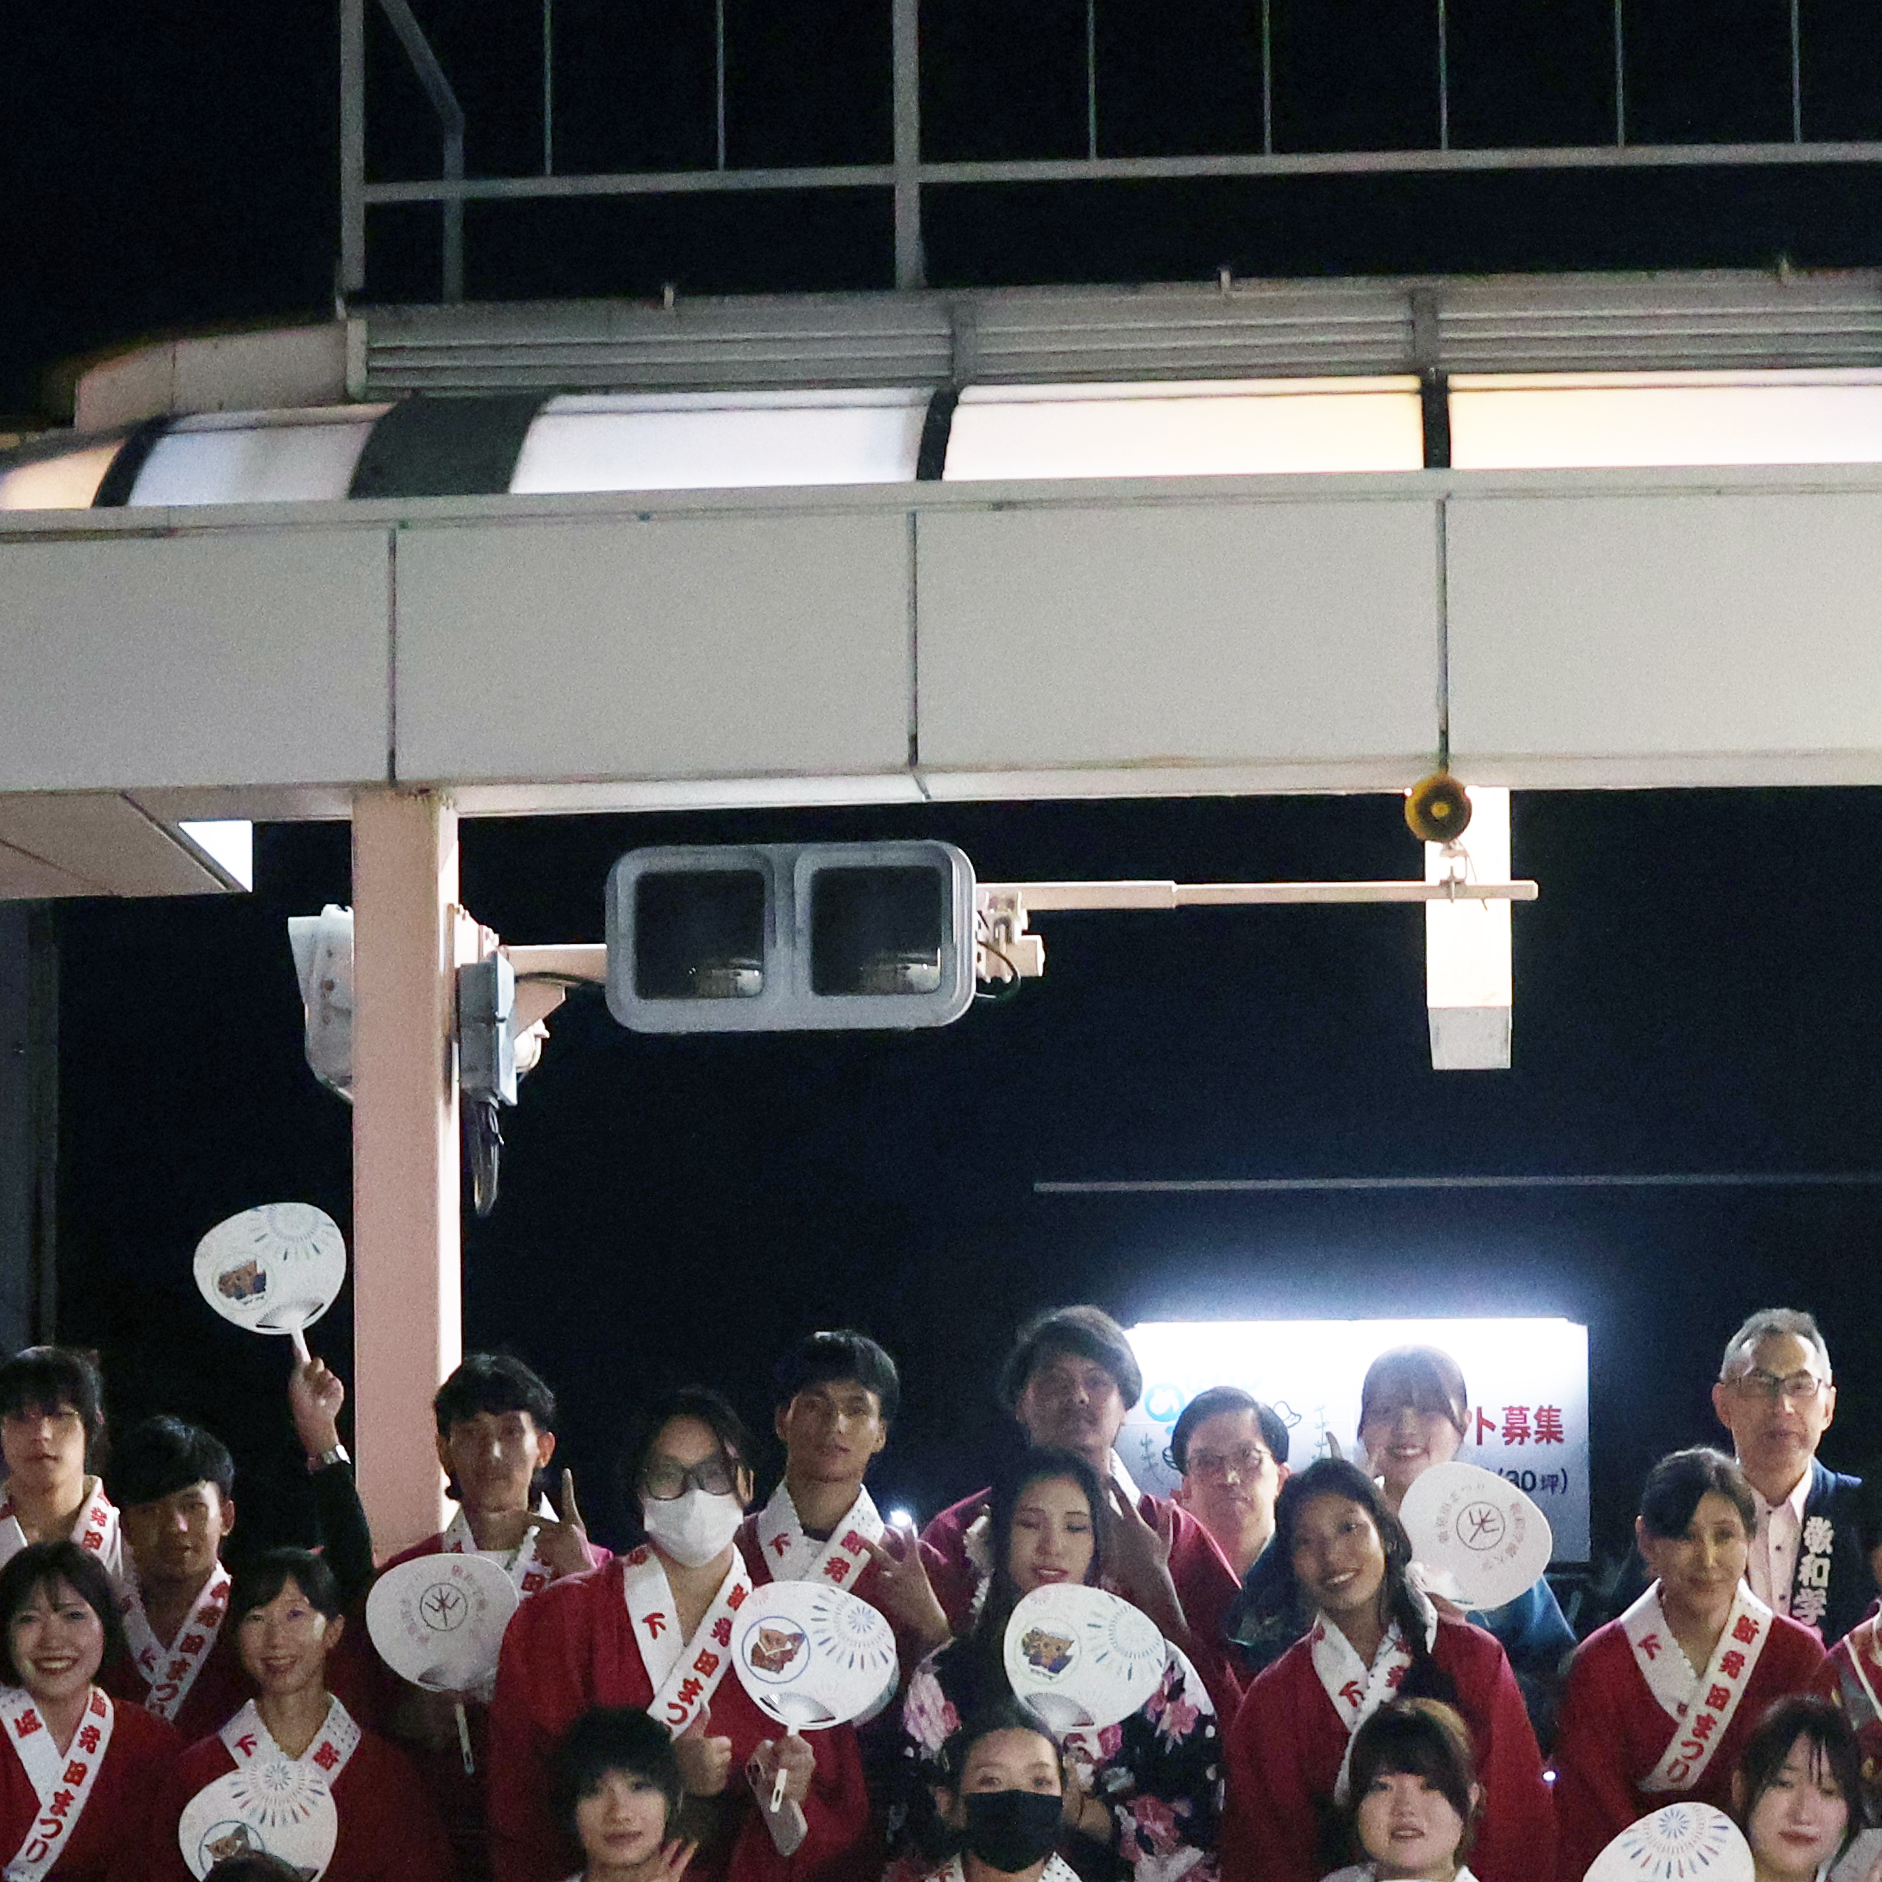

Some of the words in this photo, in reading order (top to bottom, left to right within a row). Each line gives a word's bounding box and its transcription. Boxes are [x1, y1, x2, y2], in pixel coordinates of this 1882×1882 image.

[1476, 1404, 1565, 1446] ト募集
[660, 1583, 749, 1732] 新発田まつ
[1667, 1614, 1759, 1783] 新発田まつり
